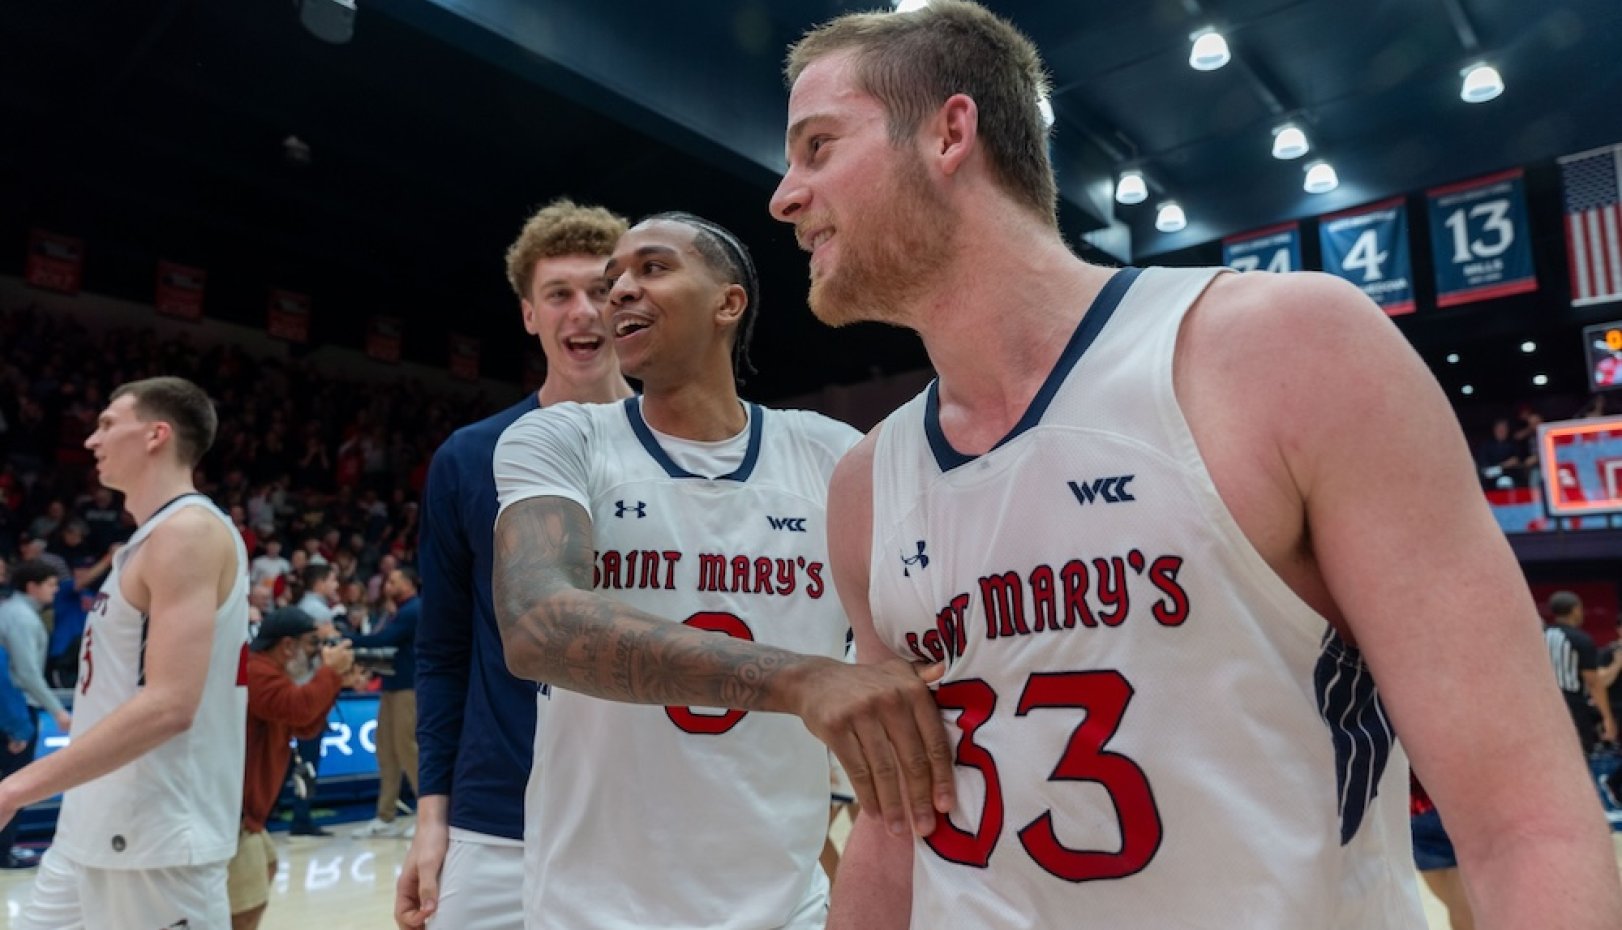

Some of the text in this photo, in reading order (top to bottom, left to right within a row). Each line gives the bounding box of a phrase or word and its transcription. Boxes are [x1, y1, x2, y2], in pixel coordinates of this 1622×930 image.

[1342, 228, 1389, 281] 4
[1444, 199, 1514, 263] 13
[1067, 474, 1136, 506] WCC
[766, 516, 807, 532] WCC
[698, 553, 825, 599] MARY'S
[978, 549, 1189, 639] MARY'S
[924, 670, 1163, 883] 33
